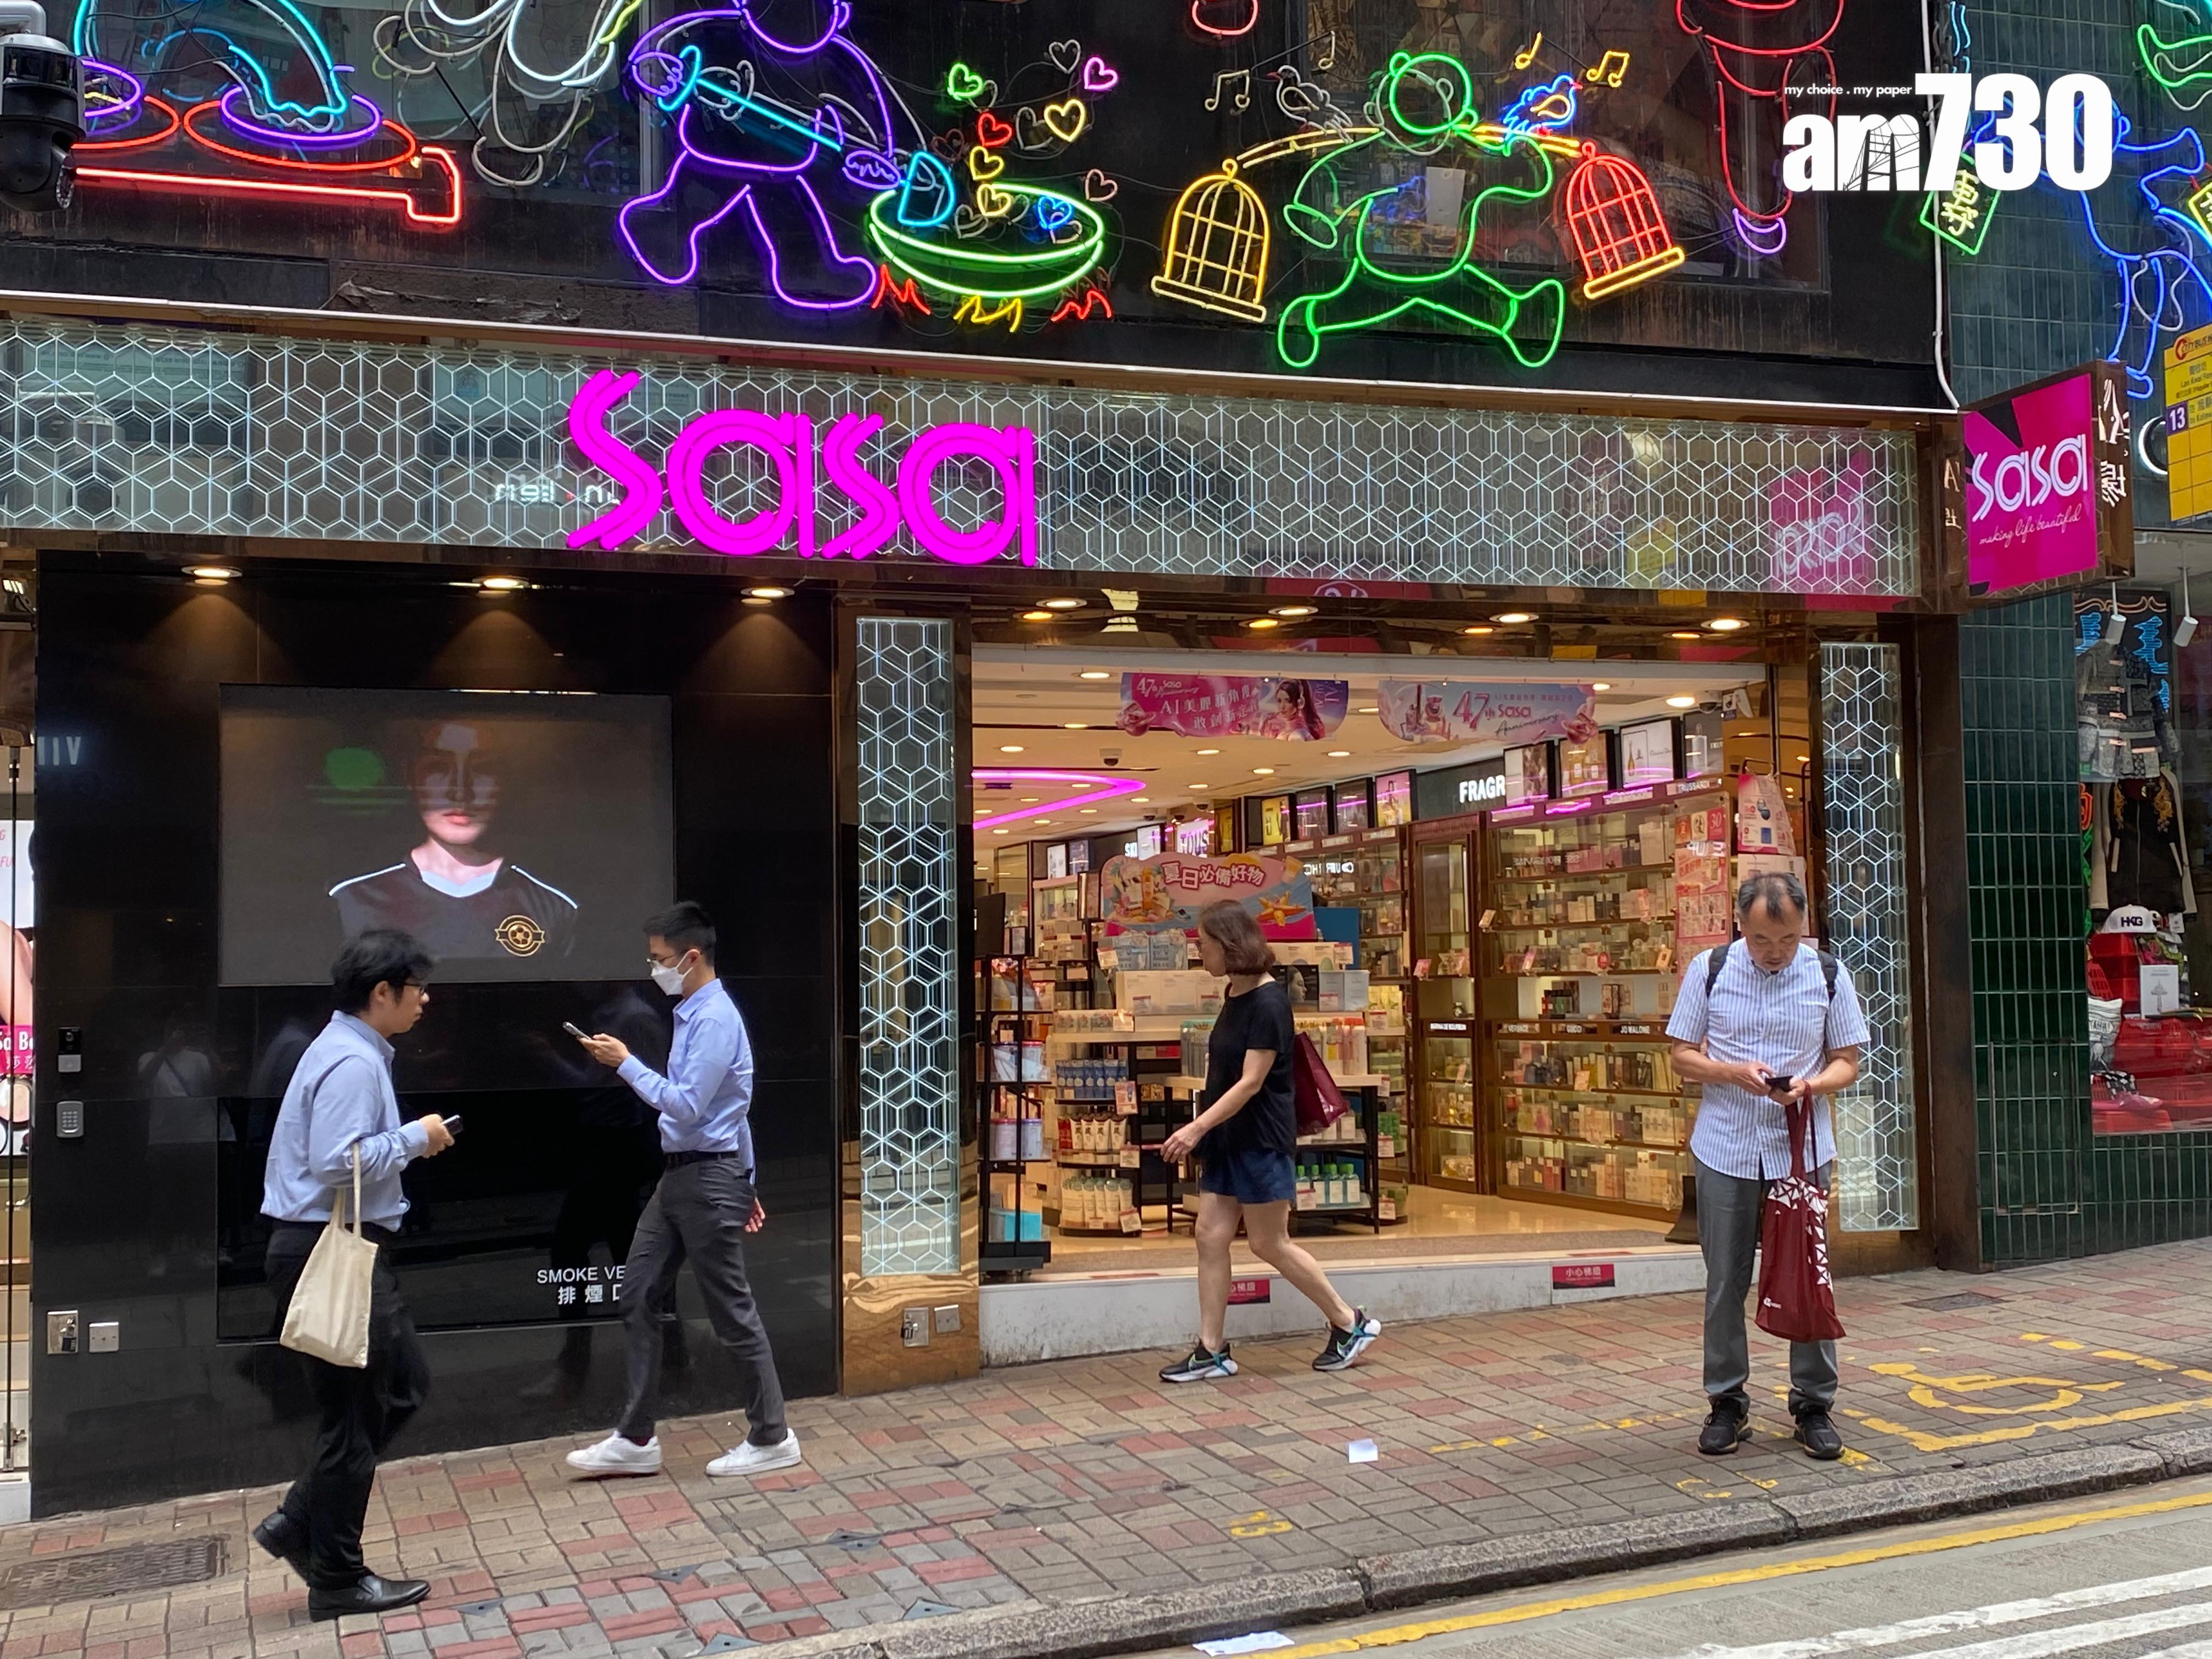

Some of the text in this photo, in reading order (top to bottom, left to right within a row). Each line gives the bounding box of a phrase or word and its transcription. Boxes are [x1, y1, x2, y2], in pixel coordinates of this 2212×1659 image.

[2169, 407, 2186, 432] 13
[1979, 503, 2081, 549] making life beautiful
[1459, 774, 1506, 804] FRAGR
[1161, 861, 1266, 890] 夏日必備好物
[2121, 916, 2143, 927] HKG
[537, 1266, 599, 1284] SMOKE
